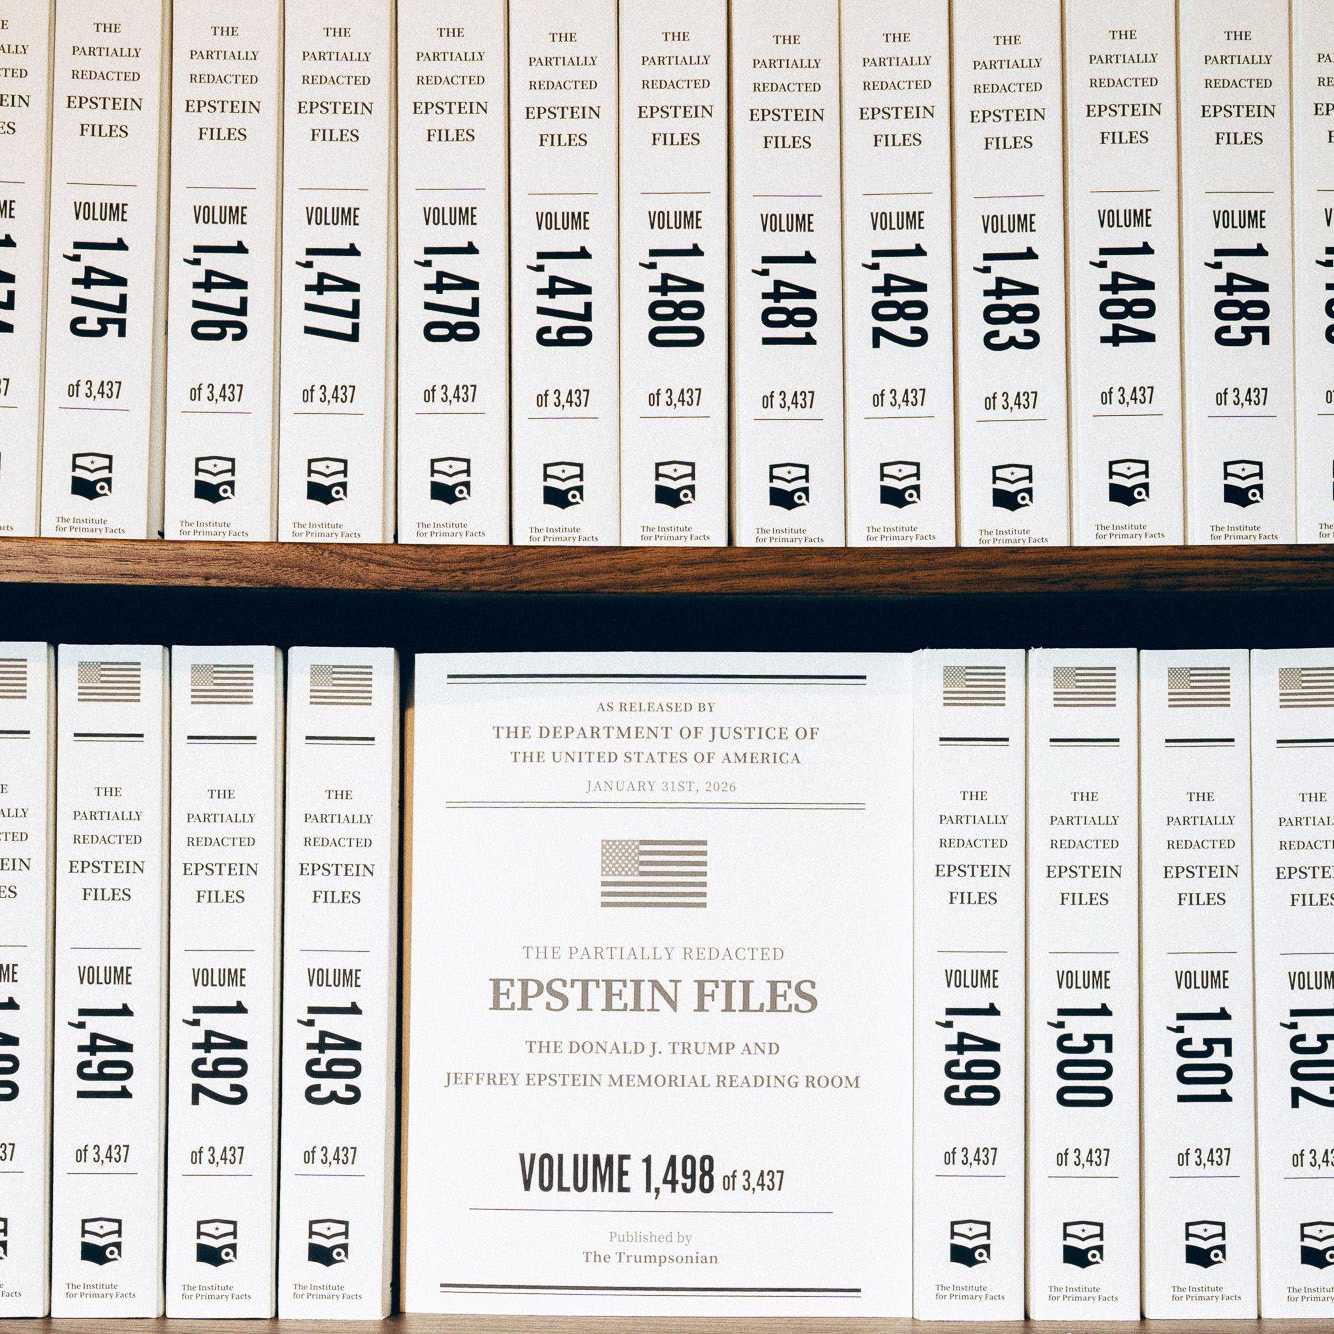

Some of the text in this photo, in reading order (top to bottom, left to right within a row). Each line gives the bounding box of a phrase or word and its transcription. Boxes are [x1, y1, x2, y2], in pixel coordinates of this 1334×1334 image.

[62, 237, 129, 338] 1,475
[295, 242, 362, 343] 1,477
[414, 241, 481, 343] 1,478
[638, 243, 705, 348] 1,480
[861, 243, 929, 349] 1,482
[1089, 241, 1157, 348] 1,484
[598, 701, 713, 713] AS RELEASED BY
[493, 725, 820, 743] THE DEPARTMENT OF JUSTICE OF
[511, 751, 801, 765] THE UNITED STATES OF AMERICA
[585, 780, 737, 794] JANUARY 31ST, 2026
[522, 945, 785, 962] THE PARTIALLY REDACTED
[489, 977, 818, 1014] EPSTEIN FILES
[67, 1003, 134, 1099] 1,491
[297, 1001, 363, 1106] 1,493
[525, 1040, 780, 1058] THE DONALD J. TRUMP AND
[1047, 1002, 1114, 1108] 1,500
[444, 1071, 860, 1089] JEFFREY EPSTEIN MEMORIAL READING ROOM
[519, 1152, 785, 1200] VOLUME 1,498 of 3,437
[582, 1250, 719, 1268] The Trumpsonian
[609, 1230, 693, 1247] Published by
